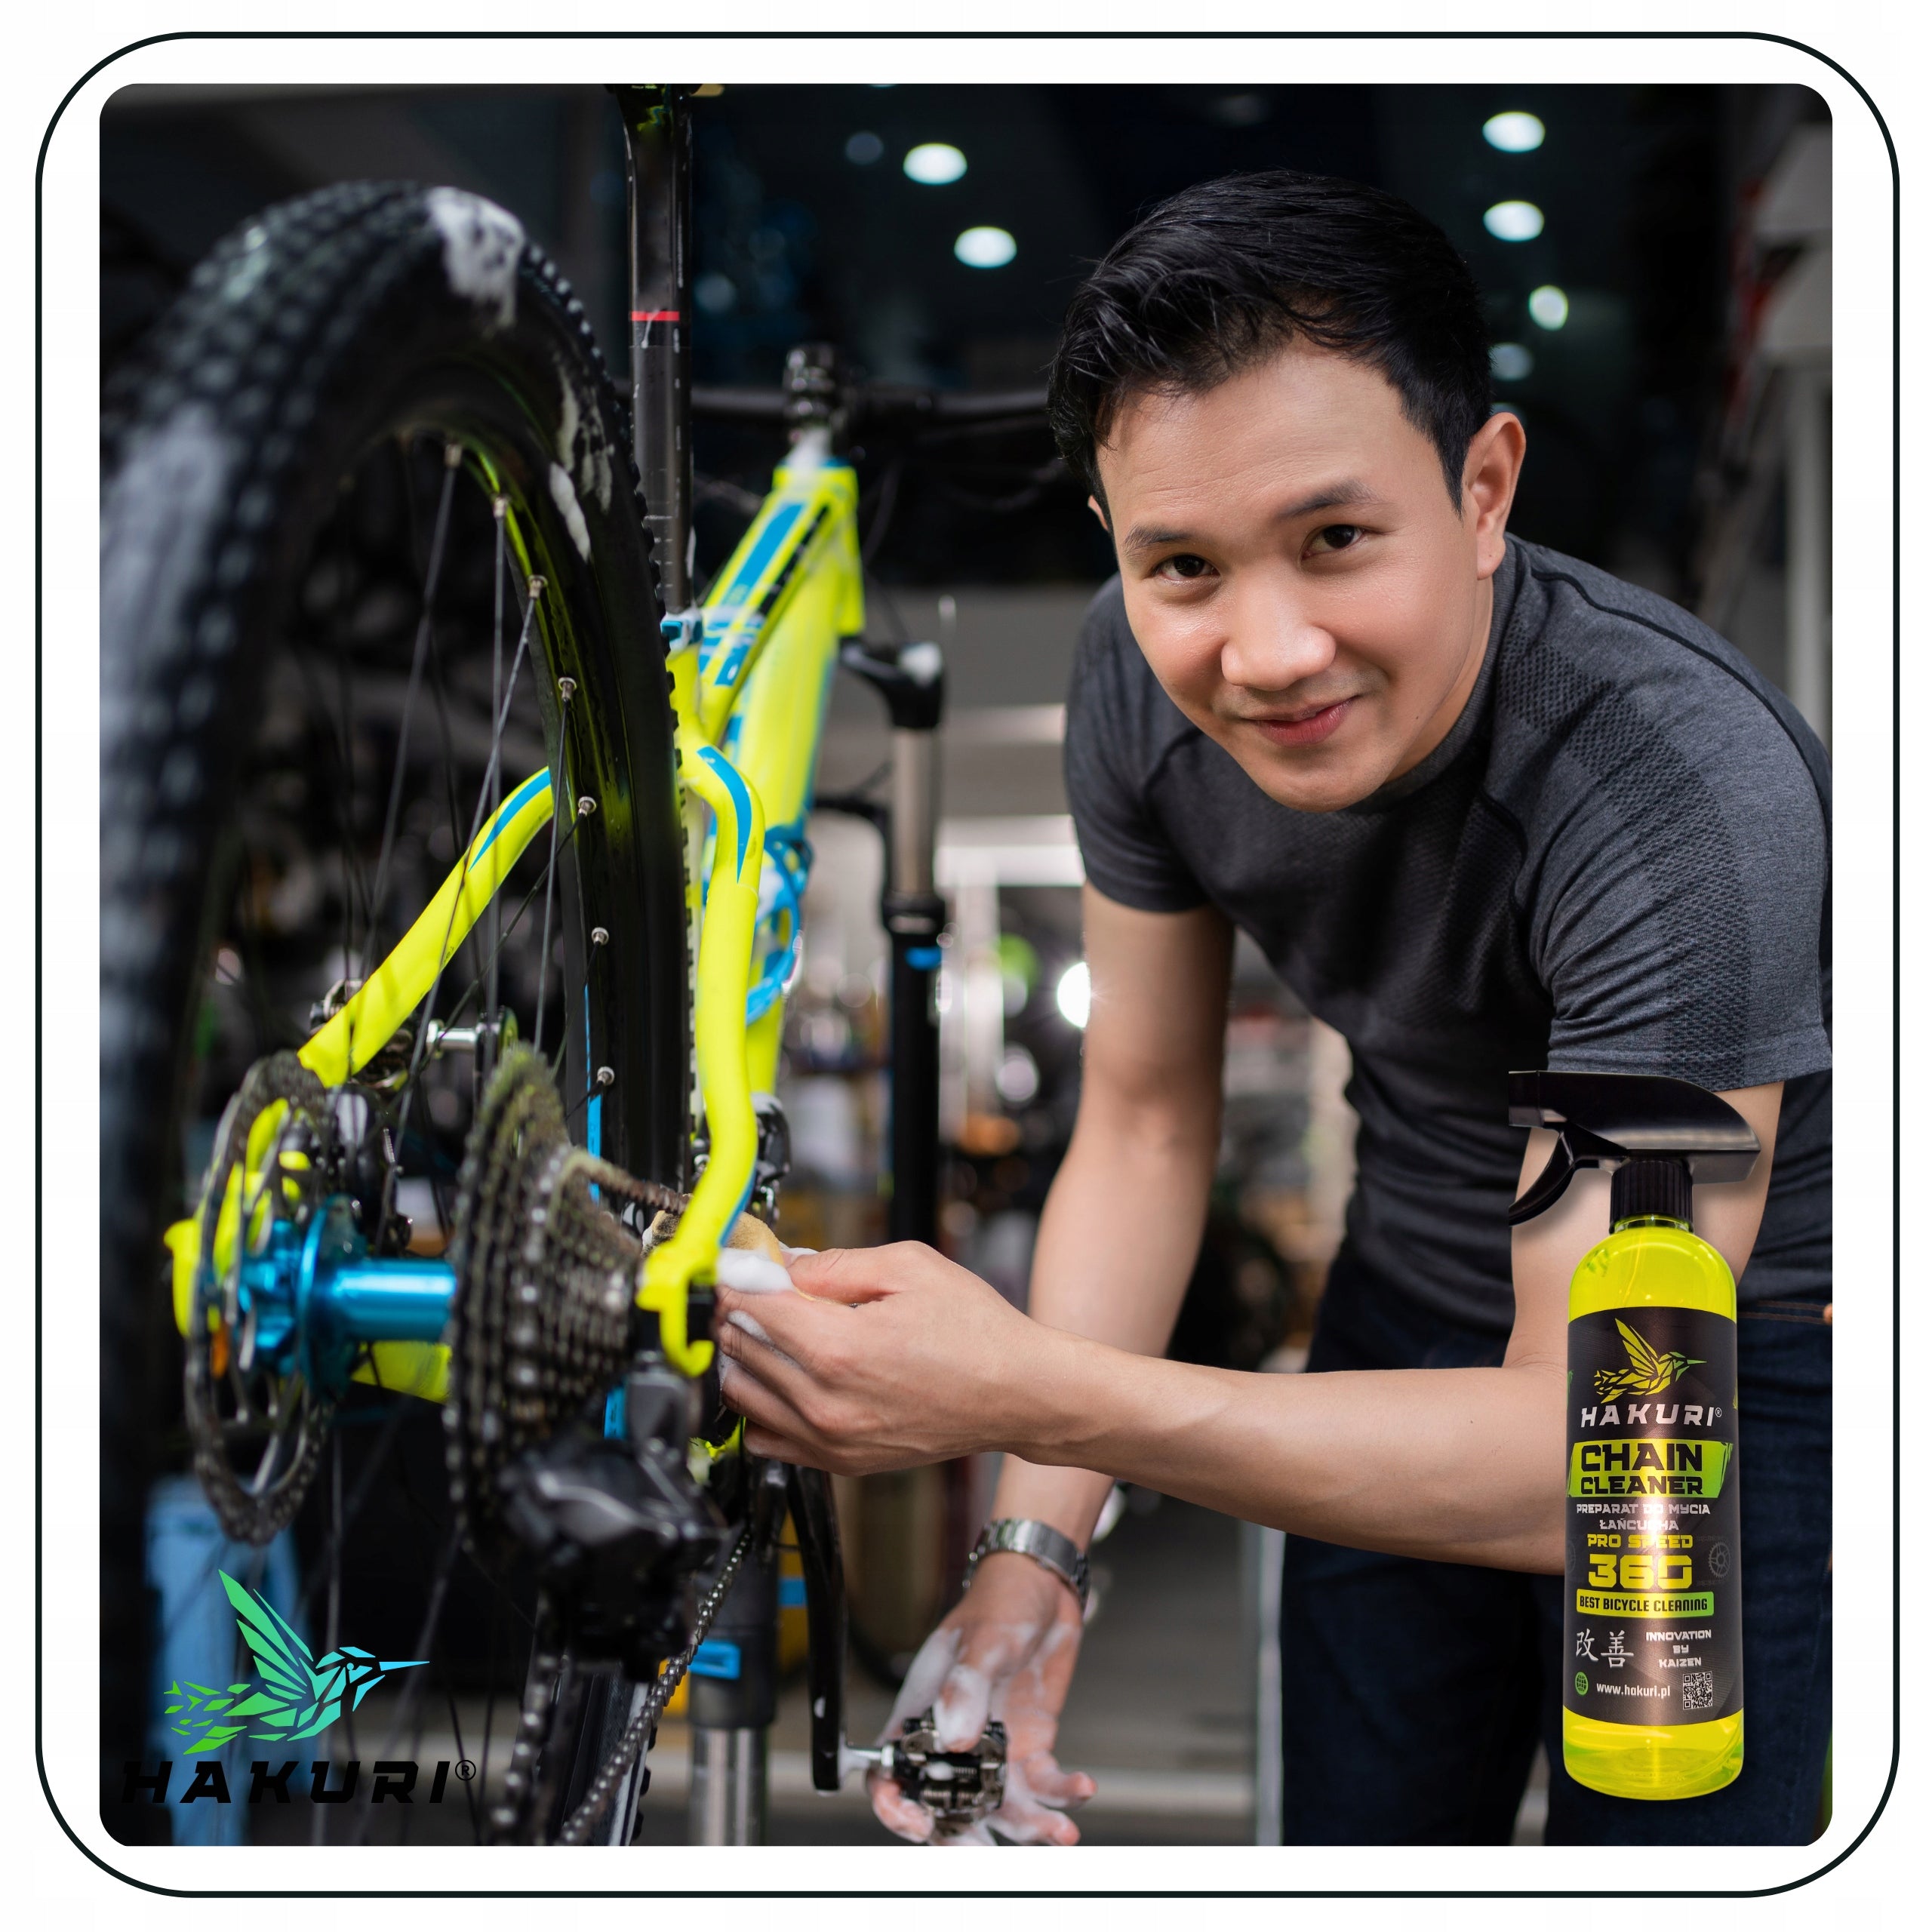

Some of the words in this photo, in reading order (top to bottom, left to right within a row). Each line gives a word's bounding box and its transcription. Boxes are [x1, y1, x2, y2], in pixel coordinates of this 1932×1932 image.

[1581, 1442, 1703, 1472] CHAIN
[1580, 1475, 1703, 1495] CLEANER
[1576, 1503, 1638, 1515] PREPARAT
[1642, 1503, 1664, 1515] DO
[1668, 1503, 1711, 1515] MYCIA
[1586, 1534, 1622, 1548] PRO
[1628, 1534, 1694, 1549] SPEED
[1588, 1553, 1692, 1589] 360
[1580, 1595, 1601, 1609] BEST
[1603, 1598, 1650, 1612] BICYCLE
[1654, 1598, 1708, 1612] CLEANING
[1645, 1629, 1712, 1641] INNOVATION
[1575, 1628, 1635, 1669] 改善
[1672, 1644, 1689, 1654] BY
[1659, 1657, 1702, 1669] KAIZEN
[1596, 1683, 1671, 1699] www.hakuri.pl
